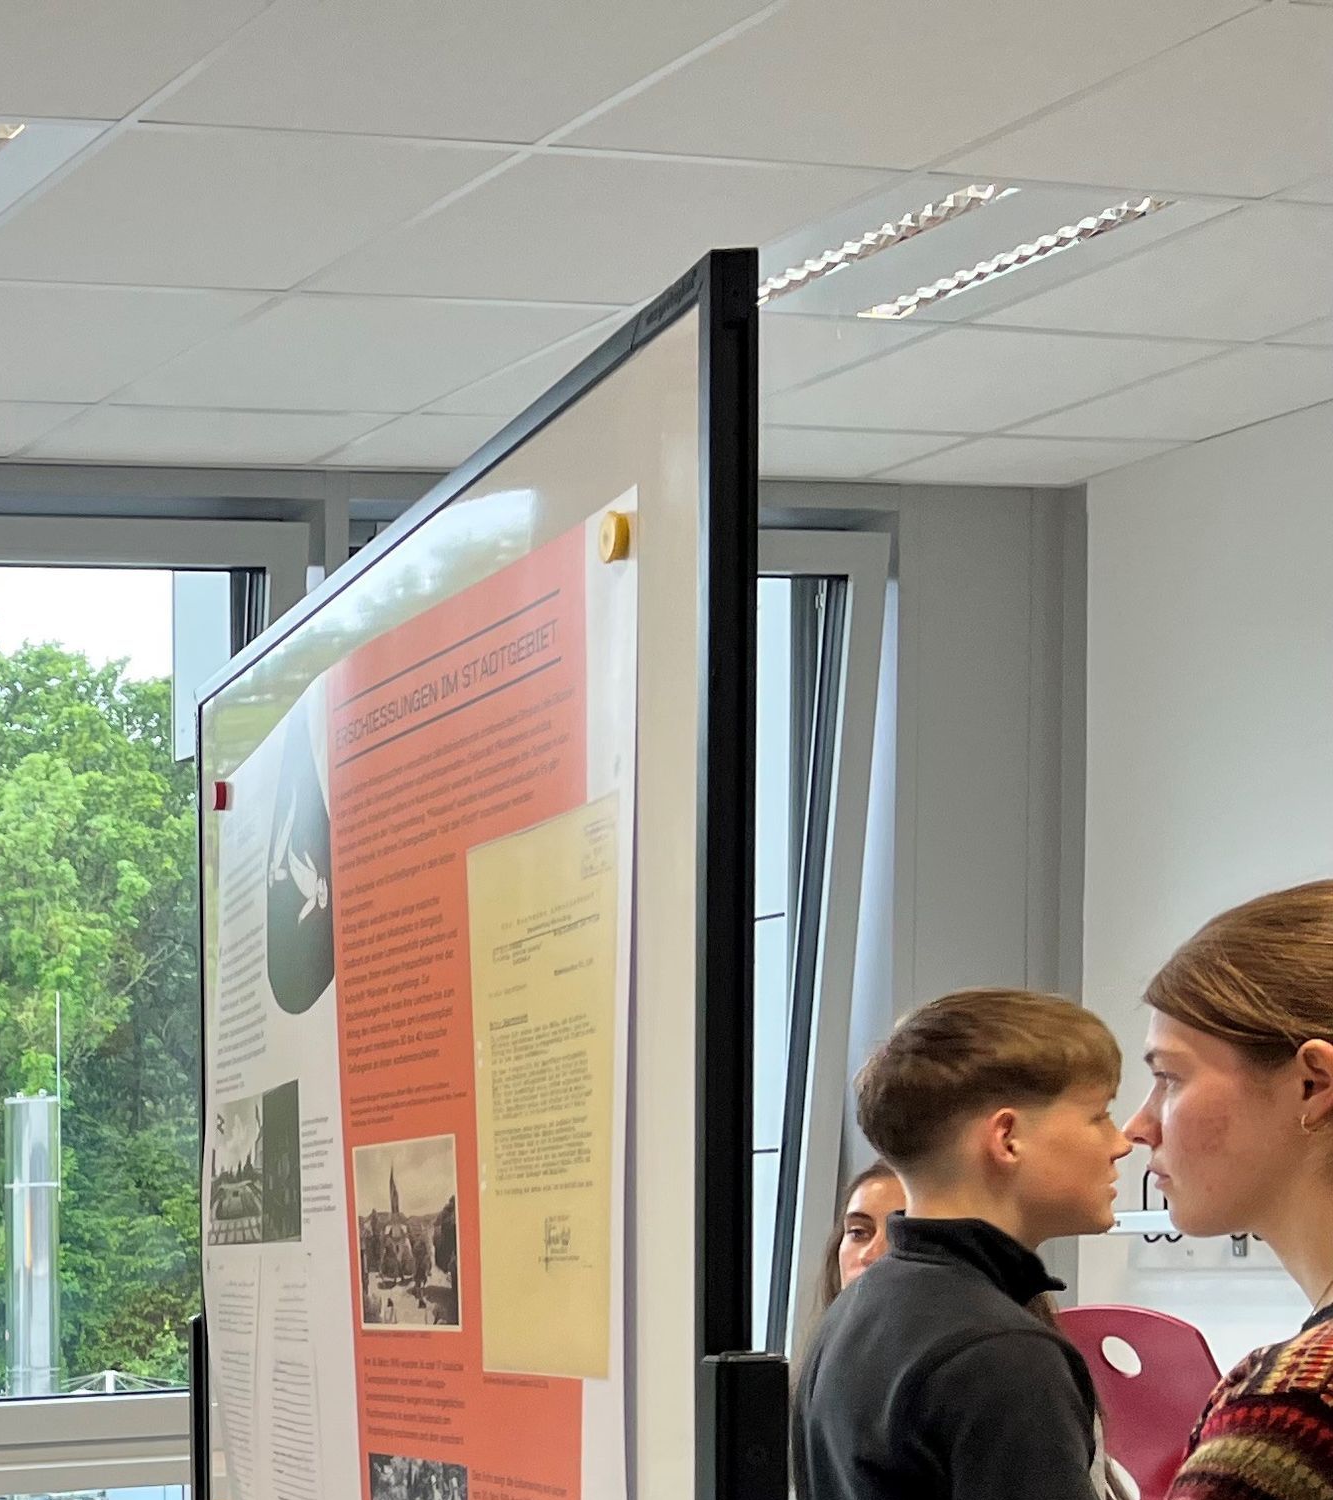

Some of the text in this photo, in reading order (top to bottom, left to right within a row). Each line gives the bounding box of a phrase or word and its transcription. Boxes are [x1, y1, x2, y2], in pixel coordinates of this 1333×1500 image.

[334, 618, 560, 751] ERSCHIESSUNGEN IM STADTGEBIET
